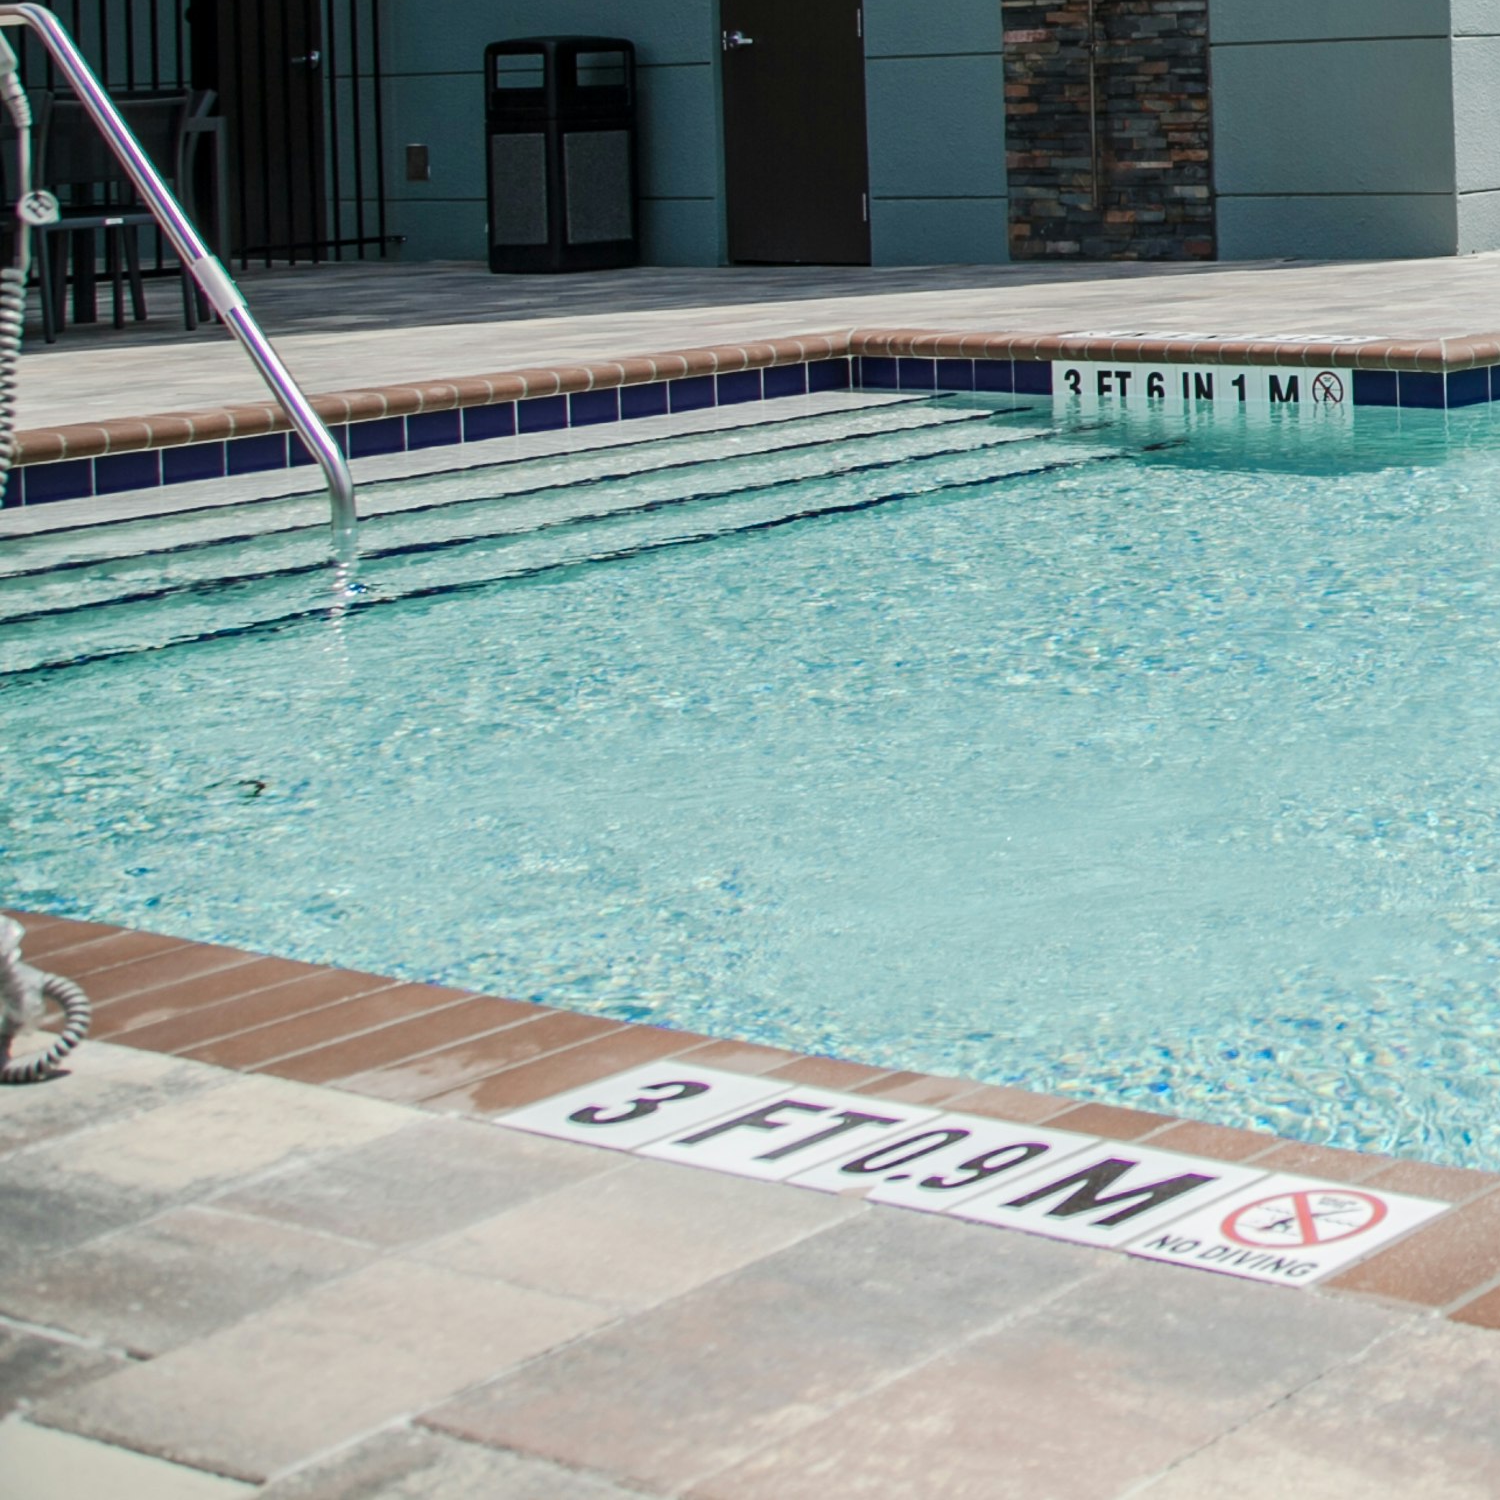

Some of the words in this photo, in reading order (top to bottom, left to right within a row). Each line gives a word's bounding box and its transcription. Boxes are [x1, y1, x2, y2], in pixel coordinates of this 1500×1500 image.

[1063, 368, 1081, 397] 3
[1097, 370, 1132, 398] FT
[1146, 372, 1165, 399] 6
[1182, 372, 1213, 400] IN
[1231, 374, 1246, 401] 1
[1269, 375, 1299, 403] M
[568, 1080, 711, 1125] 3
[671, 1099, 905, 1161] FT
[999, 1157, 1221, 1227] M
[1143, 1234, 1202, 1254] NO
[1198, 1245, 1319, 1278] DIVING
